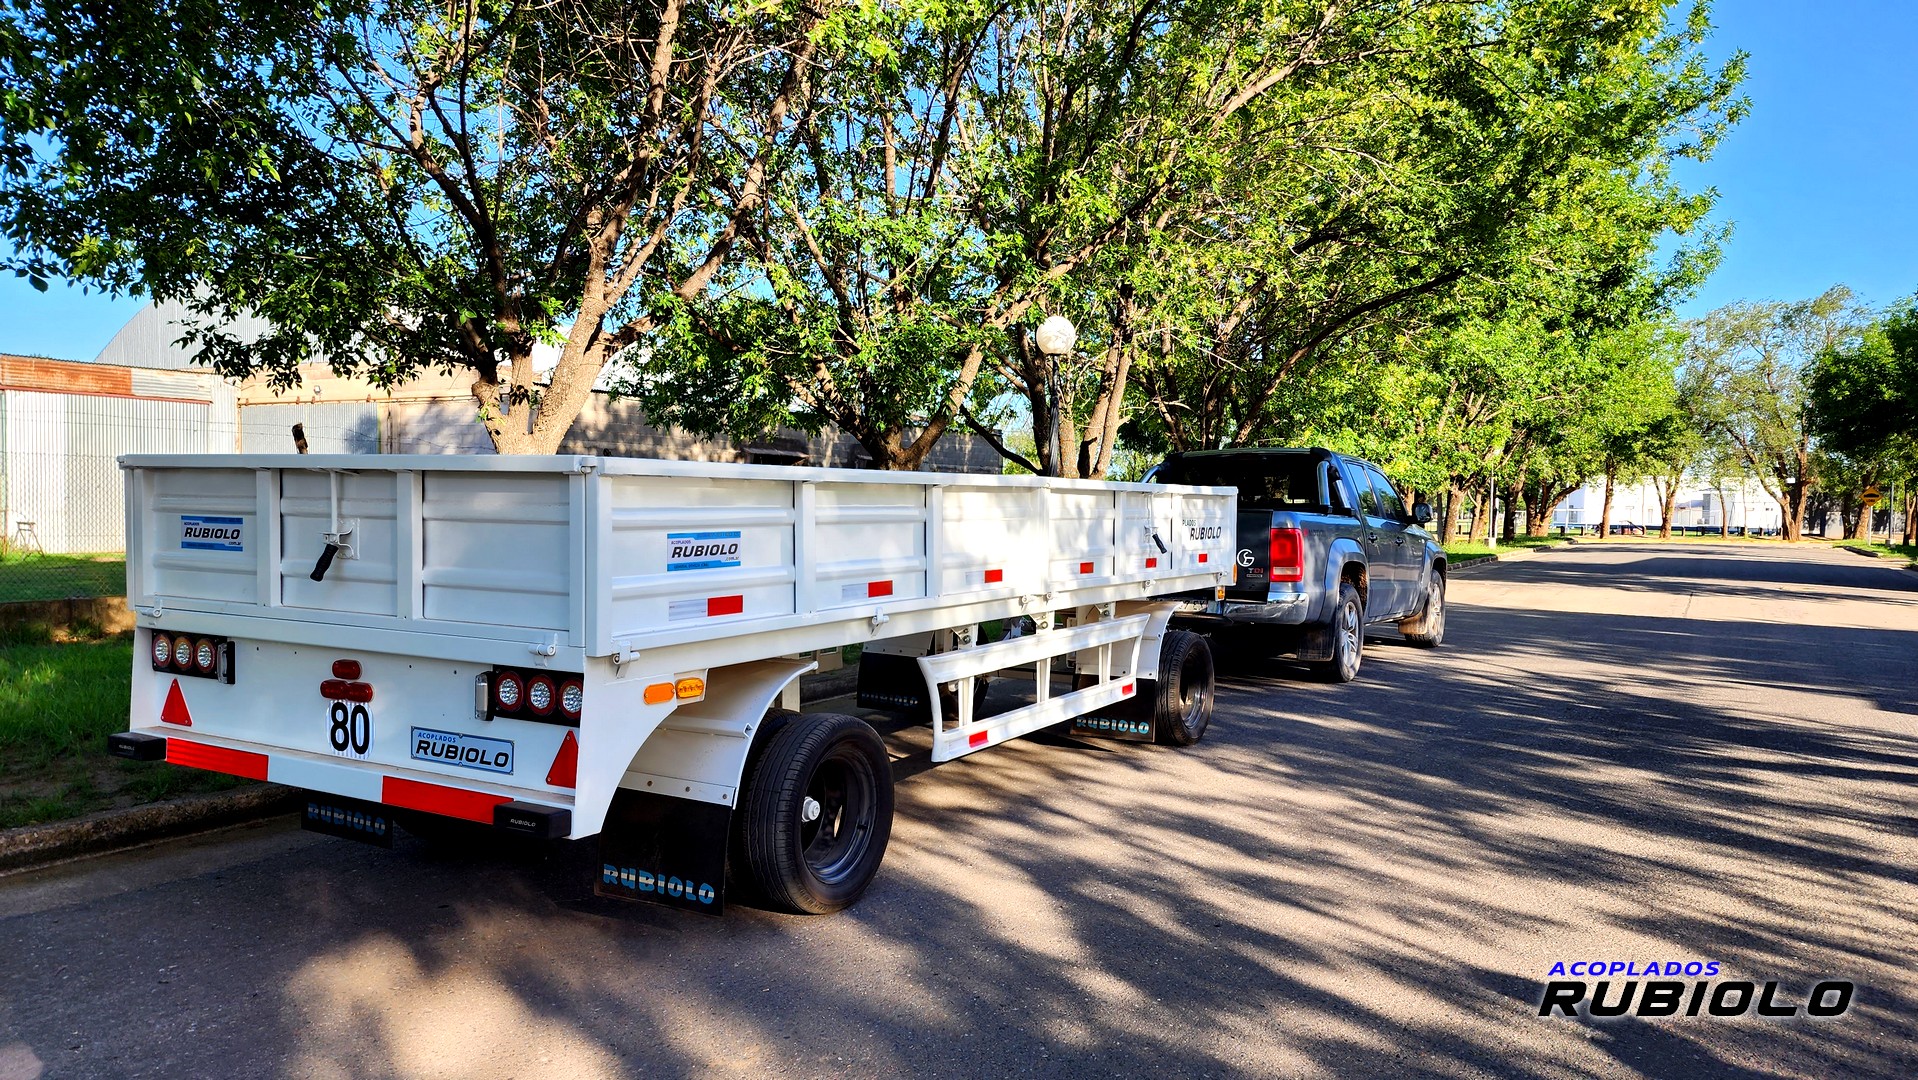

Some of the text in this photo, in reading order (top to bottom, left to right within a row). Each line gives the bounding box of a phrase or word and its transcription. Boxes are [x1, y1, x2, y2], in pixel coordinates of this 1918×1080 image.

[185, 527, 240, 540] RUBIOLO
[1190, 527, 1221, 540] RUBIOLO
[672, 543, 738, 558] RUBIOLO
[330, 702, 370, 755] 80
[1077, 716, 1149, 734] RUBIOLO
[418, 732, 456, 743] ACOPLADOS
[416, 740, 509, 767] RUBIOLO
[308, 802, 385, 835] RUBIOLO
[510, 818, 536, 827] RUBIOLO
[603, 864, 714, 904] RUBIOLO
